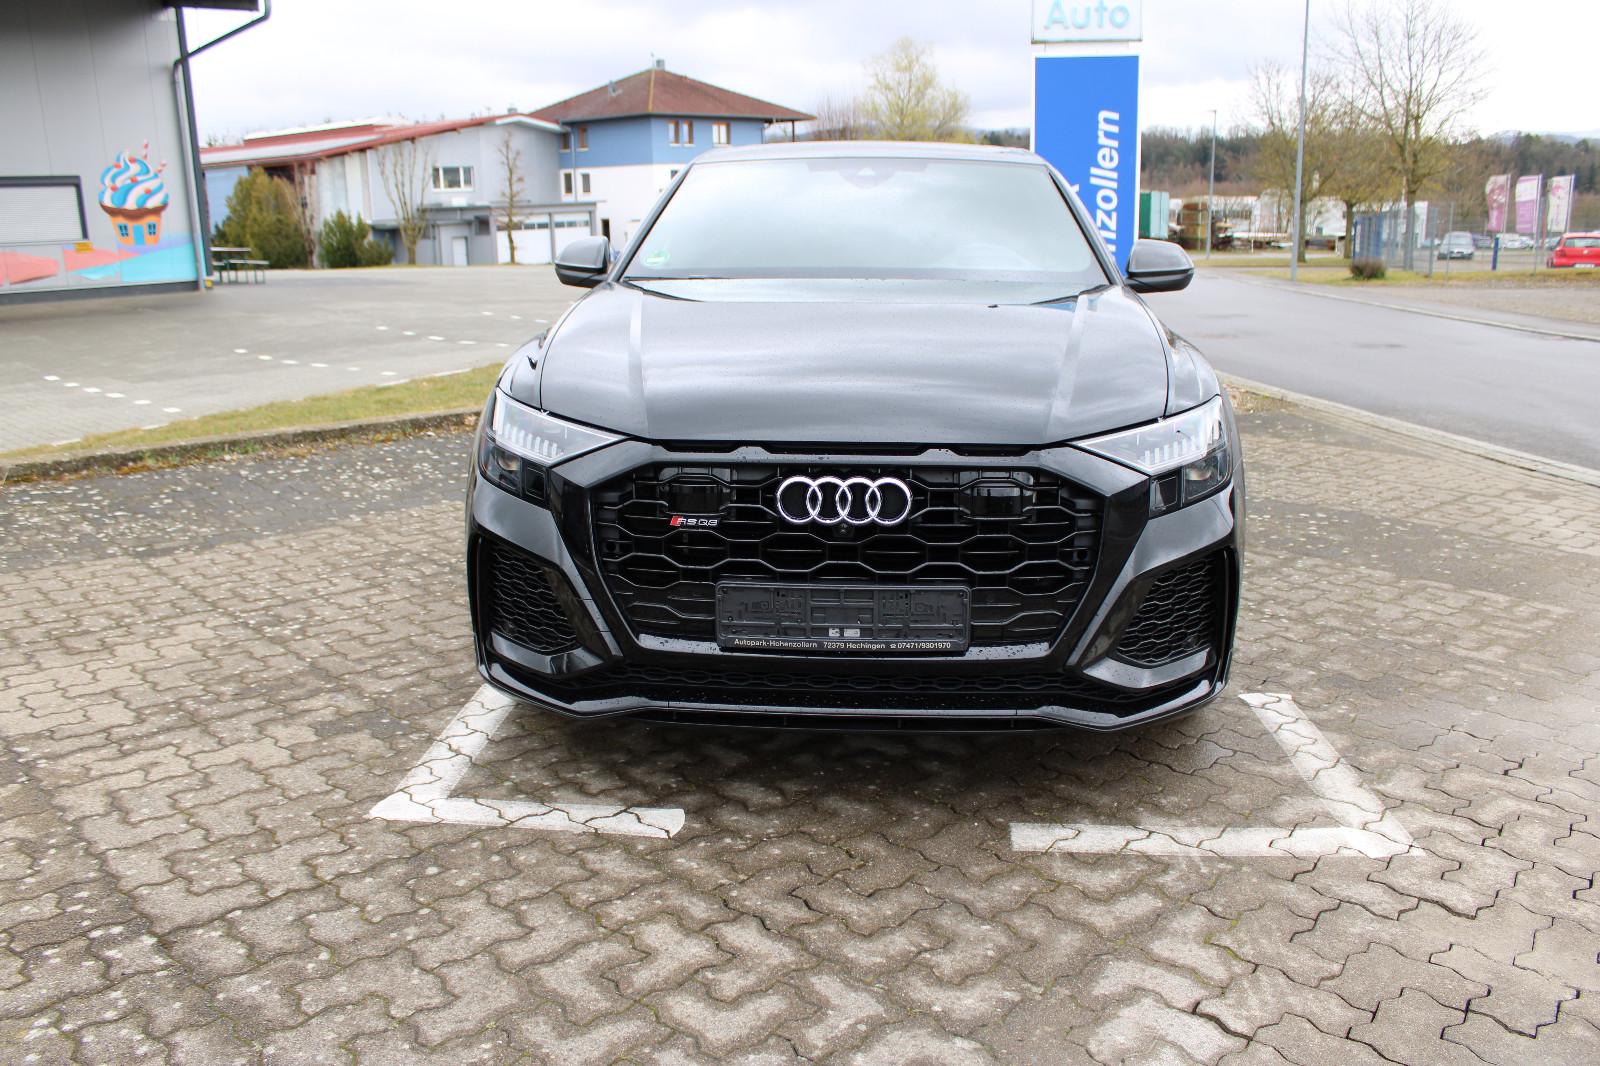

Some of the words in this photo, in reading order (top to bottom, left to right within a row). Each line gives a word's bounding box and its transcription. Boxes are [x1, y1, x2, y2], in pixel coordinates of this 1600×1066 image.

[1043, 0, 1131, 29] Auto
[1090, 109, 1120, 262] nzollern
[733, 638, 818, 649] Autopark-Hohenzollern
[823, 641, 845, 649] 72379
[846, 642, 886, 651] Hechingen
[897, 641, 952, 650] 07471/9301970
